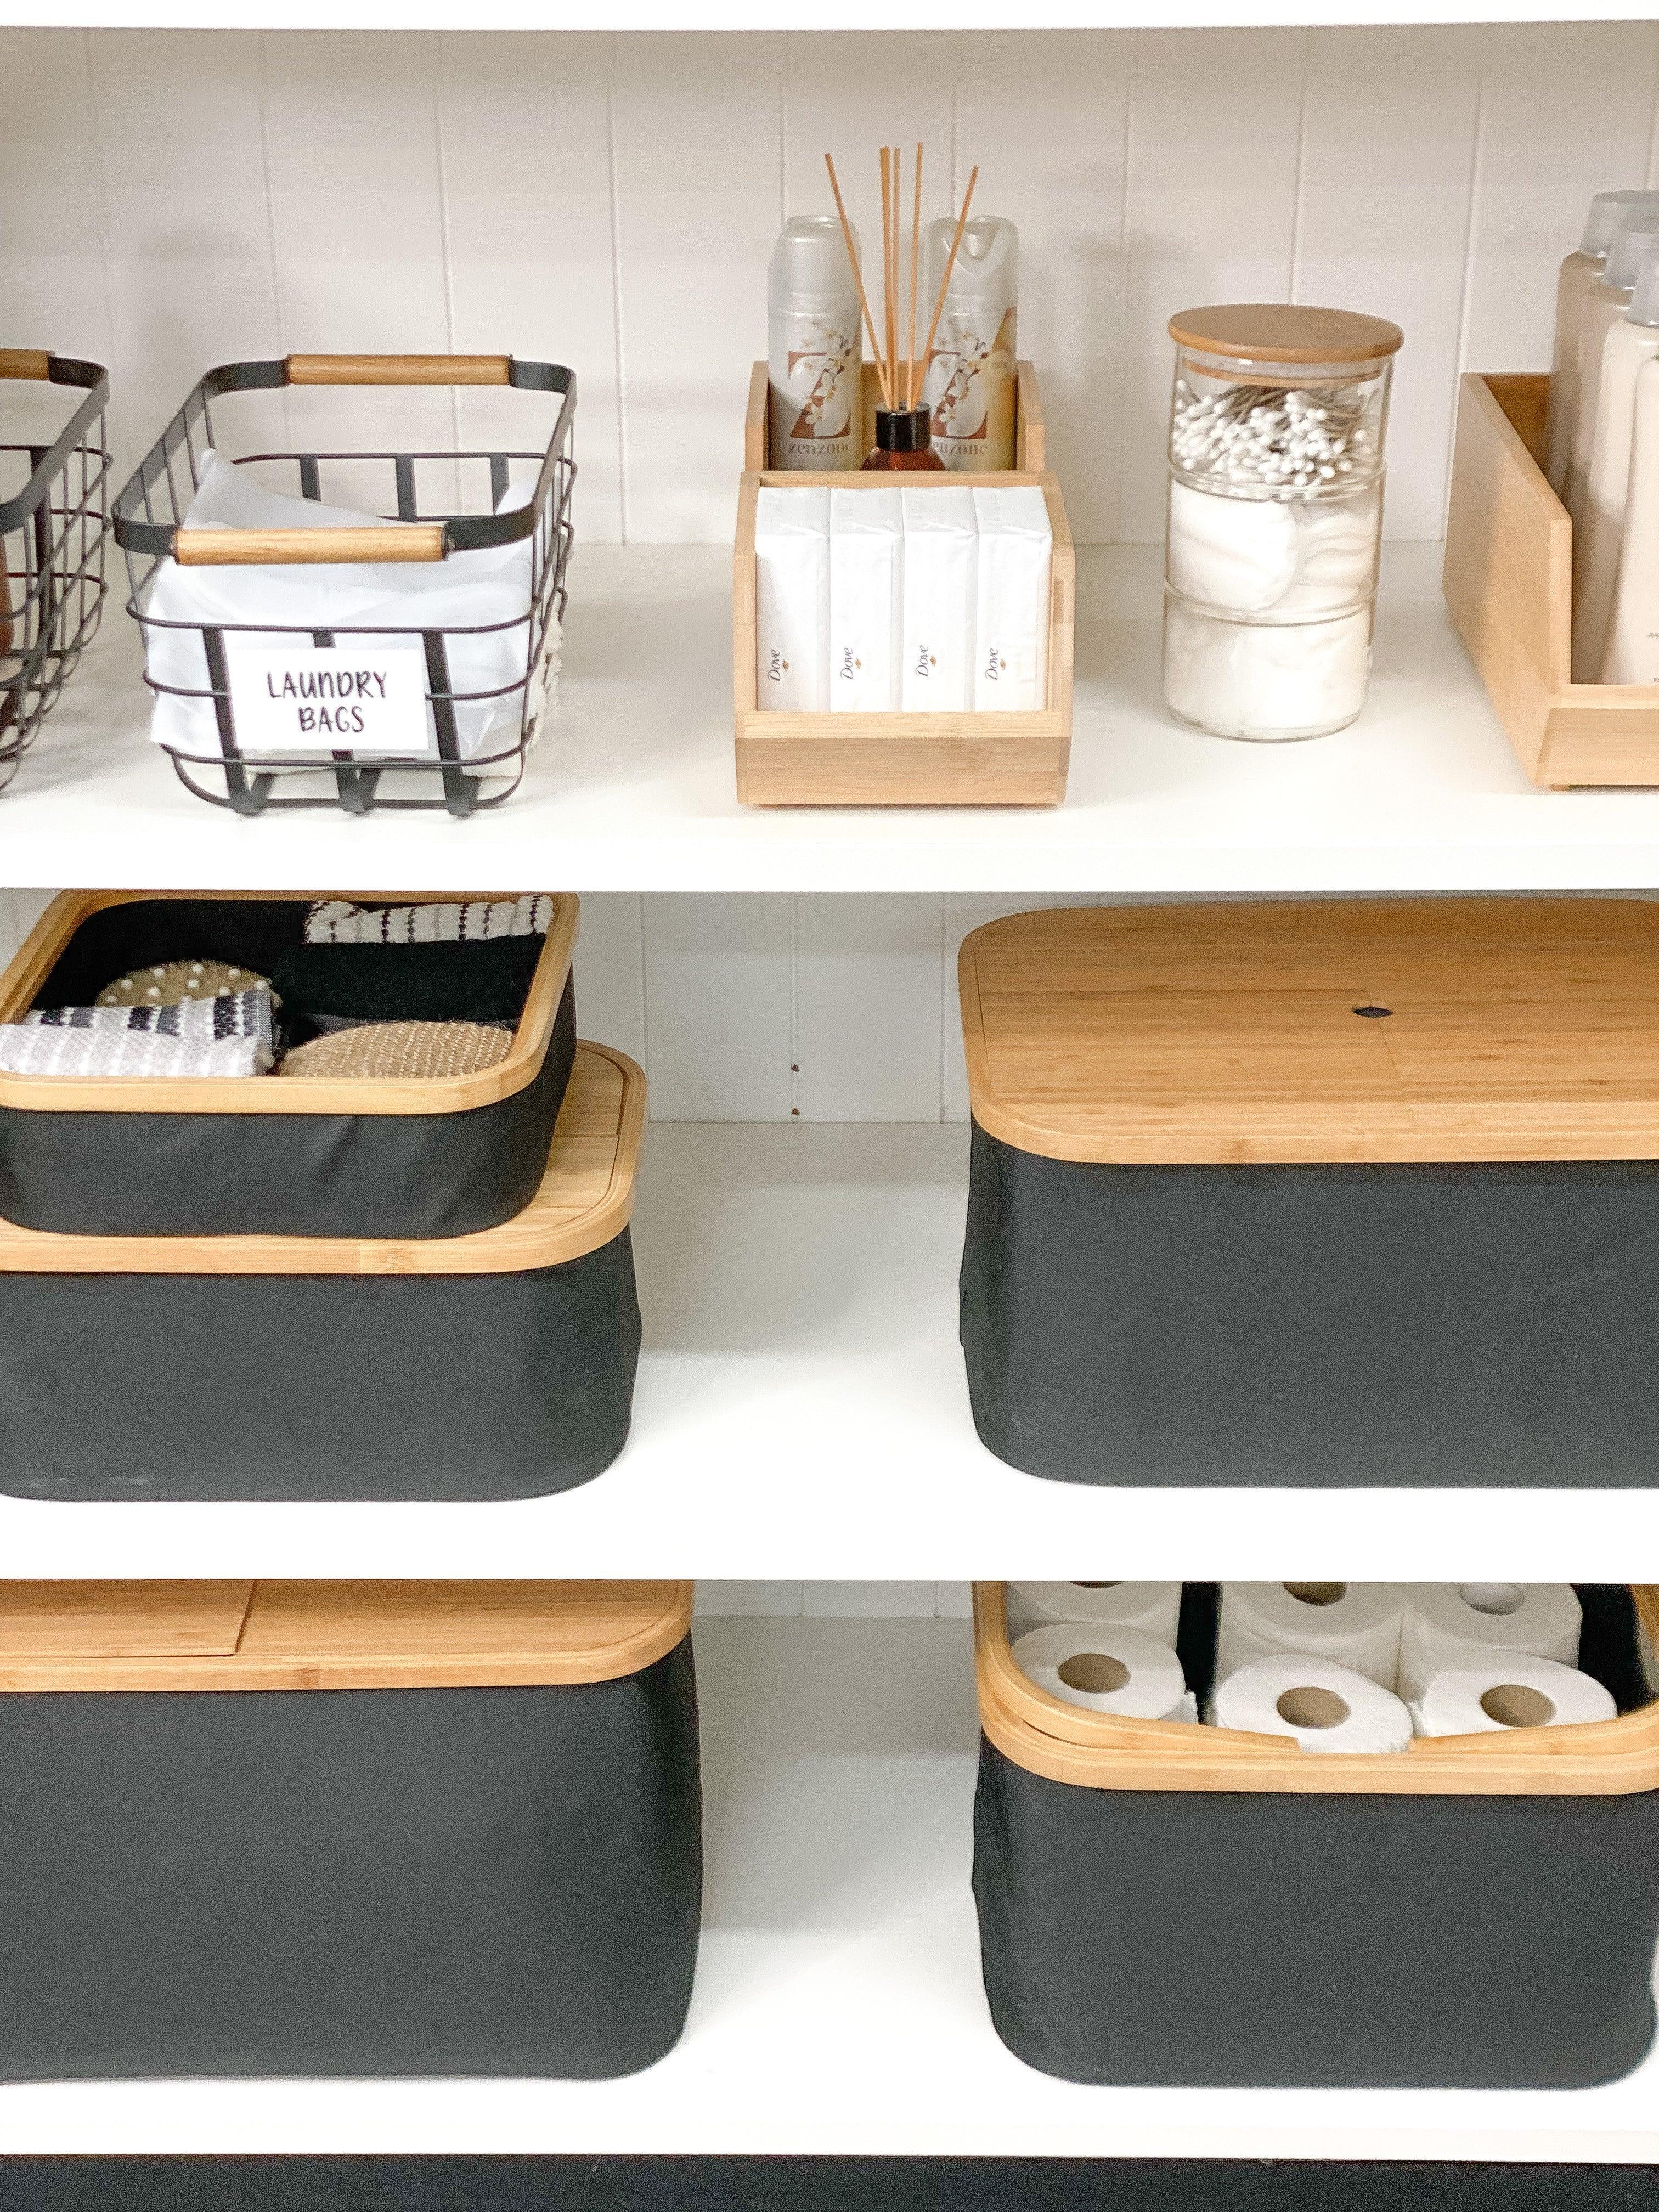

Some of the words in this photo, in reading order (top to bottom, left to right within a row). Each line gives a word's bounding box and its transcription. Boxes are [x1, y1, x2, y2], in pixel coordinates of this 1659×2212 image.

[932, 442, 988, 455] enzone
[768, 649, 781, 682] Dove
[840, 647, 854, 680] Dove
[916, 645, 929, 677] Dove
[985, 648, 998, 681] Dove
[267, 670, 387, 699] LAUNDRY
[298, 706, 365, 732] BAGS
